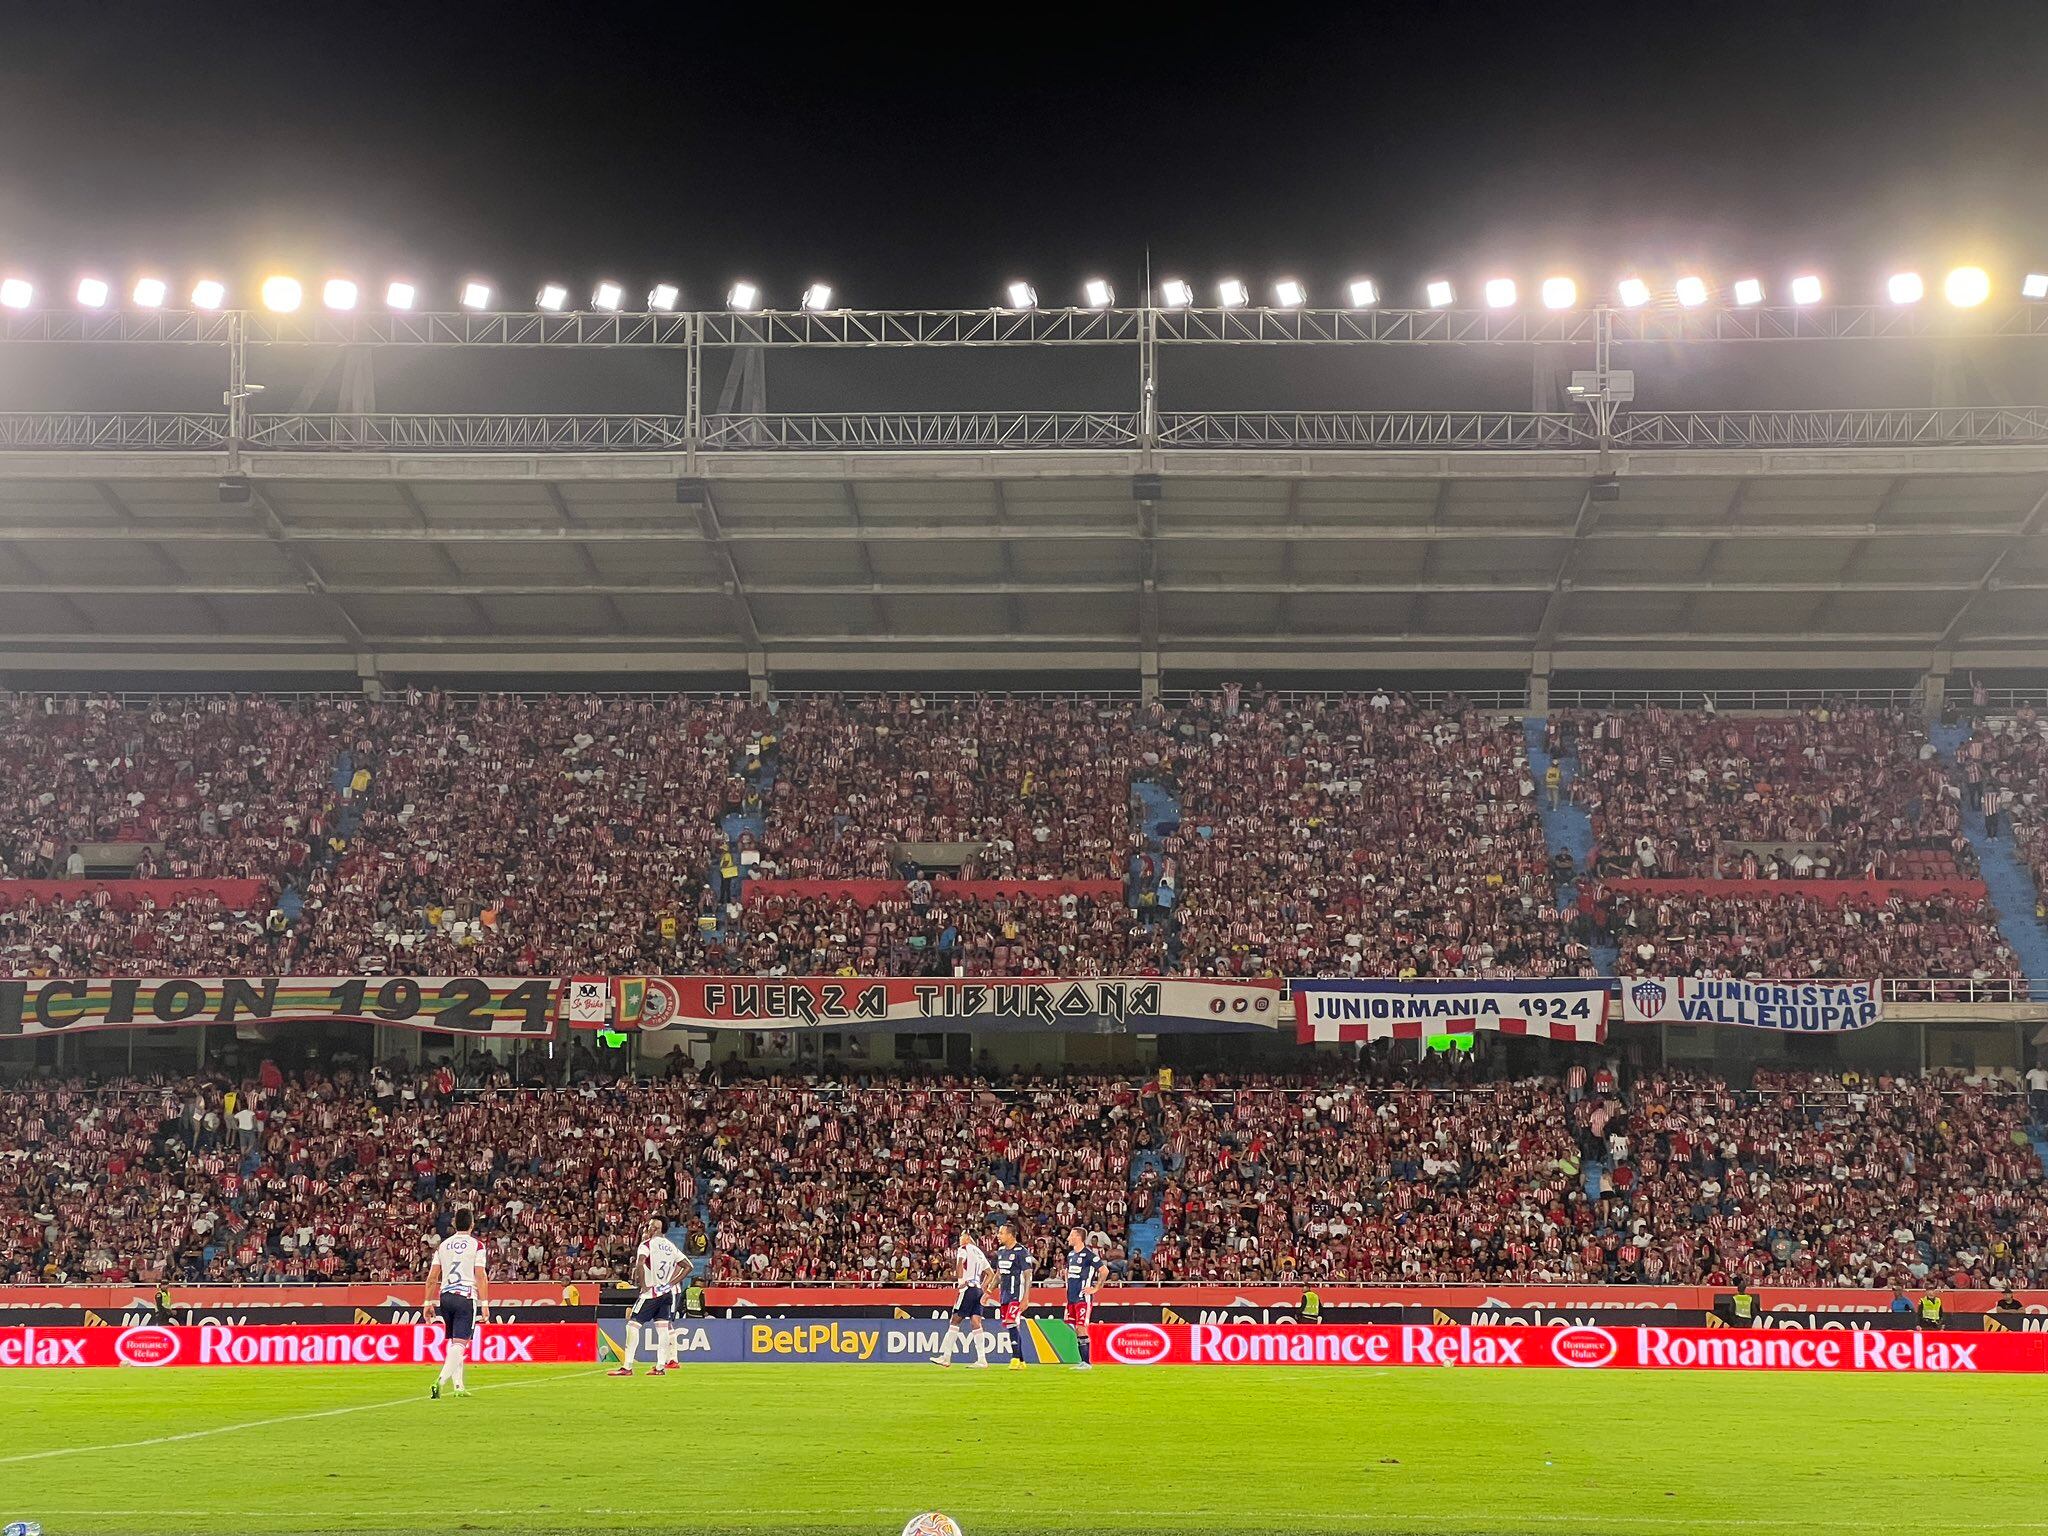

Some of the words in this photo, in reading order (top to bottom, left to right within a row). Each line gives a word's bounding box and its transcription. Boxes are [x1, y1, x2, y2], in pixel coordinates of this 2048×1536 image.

[329, 978, 551, 1031] 1924
[704, 985, 887, 1026] FUERZA
[913, 983, 1161, 1026] TIBURONA
[1313, 997, 1501, 1019] JUNIORMANIA
[1518, 997, 1591, 1020] 1924
[1690, 981, 1867, 1006] JUNIORISTAS
[1678, 999, 1876, 1031] VALLEDUPAR
[0, 1328, 87, 1365] elax
[200, 1326, 400, 1363] Romance
[413, 1325, 535, 1362] Rlax
[644, 1327, 711, 1351] LGA
[751, 1323, 879, 1360] BetPlay
[1190, 1325, 1389, 1363] Romance
[1402, 1326, 1523, 1364] Relax
[1637, 1327, 1840, 1368] Romance
[1854, 1331, 1978, 1370] Relax
